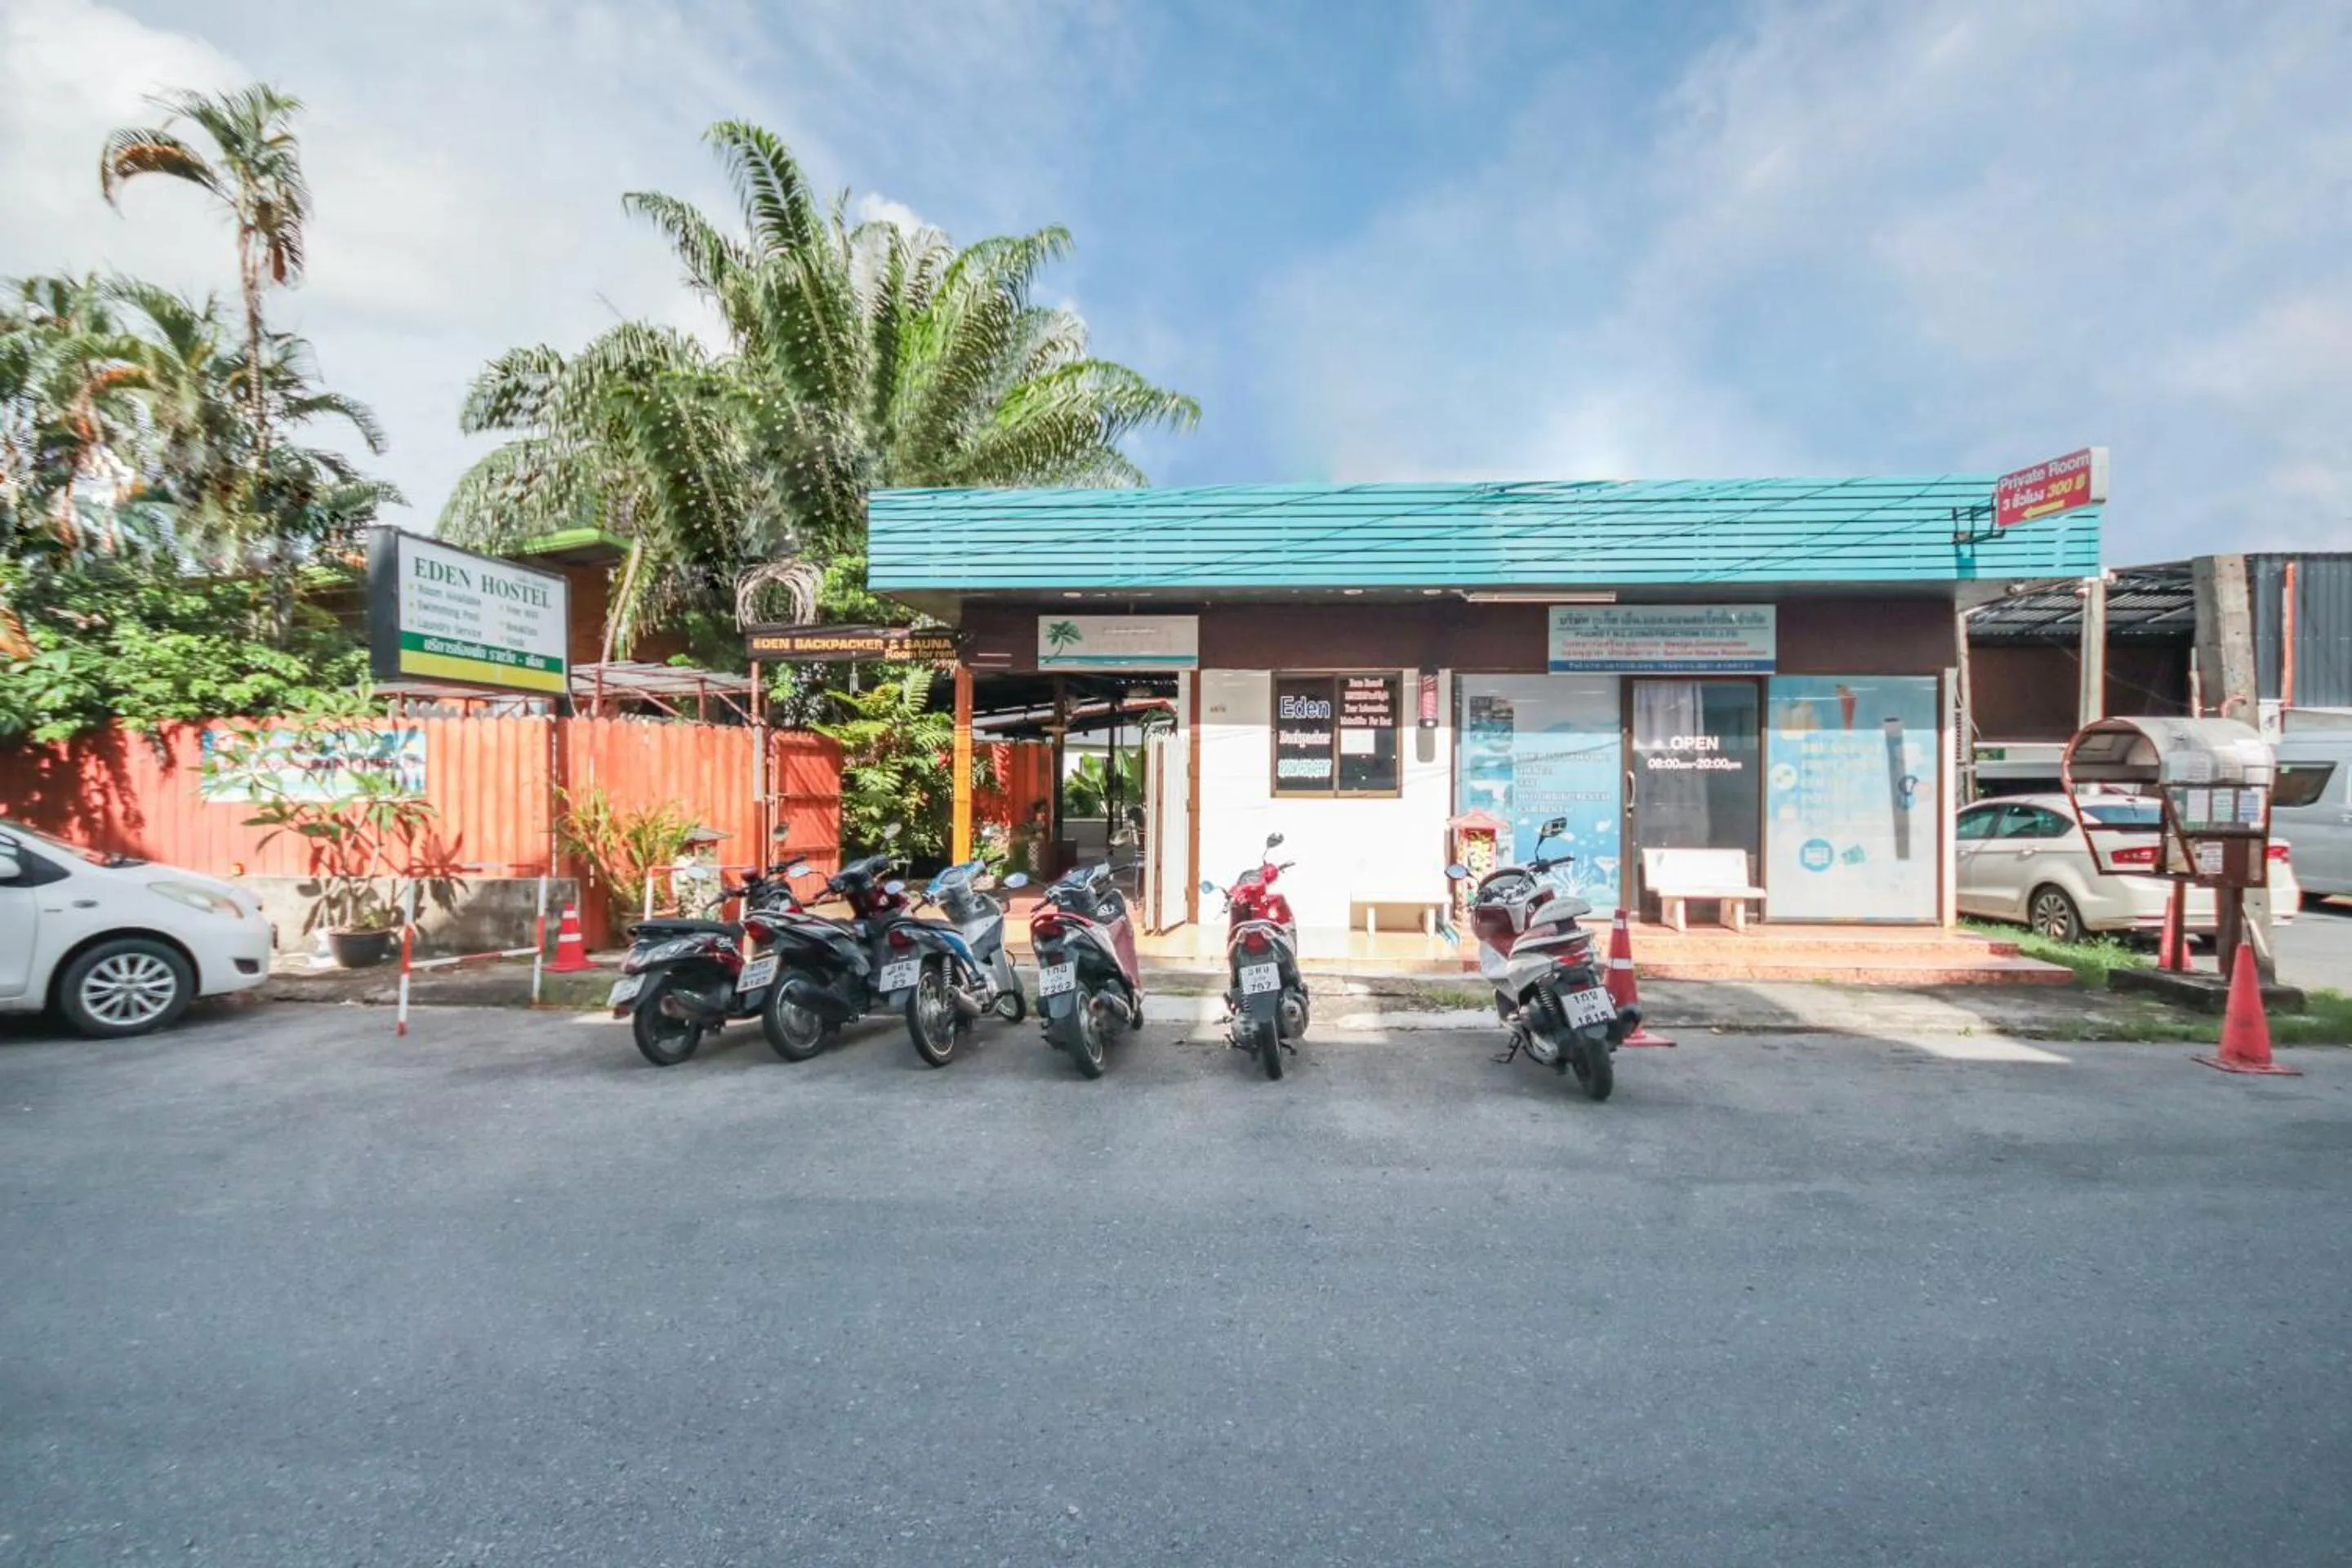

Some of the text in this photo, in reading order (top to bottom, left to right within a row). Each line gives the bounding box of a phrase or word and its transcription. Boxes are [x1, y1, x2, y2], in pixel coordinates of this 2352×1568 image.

[1998, 455, 2089, 493] Private Room
[413, 556, 472, 590] EDEN
[480, 574, 552, 609] HOSTEL
[752, 637, 791, 650] EDEN
[794, 638, 884, 651] BACKPACKER
[903, 638, 952, 649] SAUNA
[1280, 695, 1330, 719] Eden
[1670, 735, 1719, 751] OPEN
